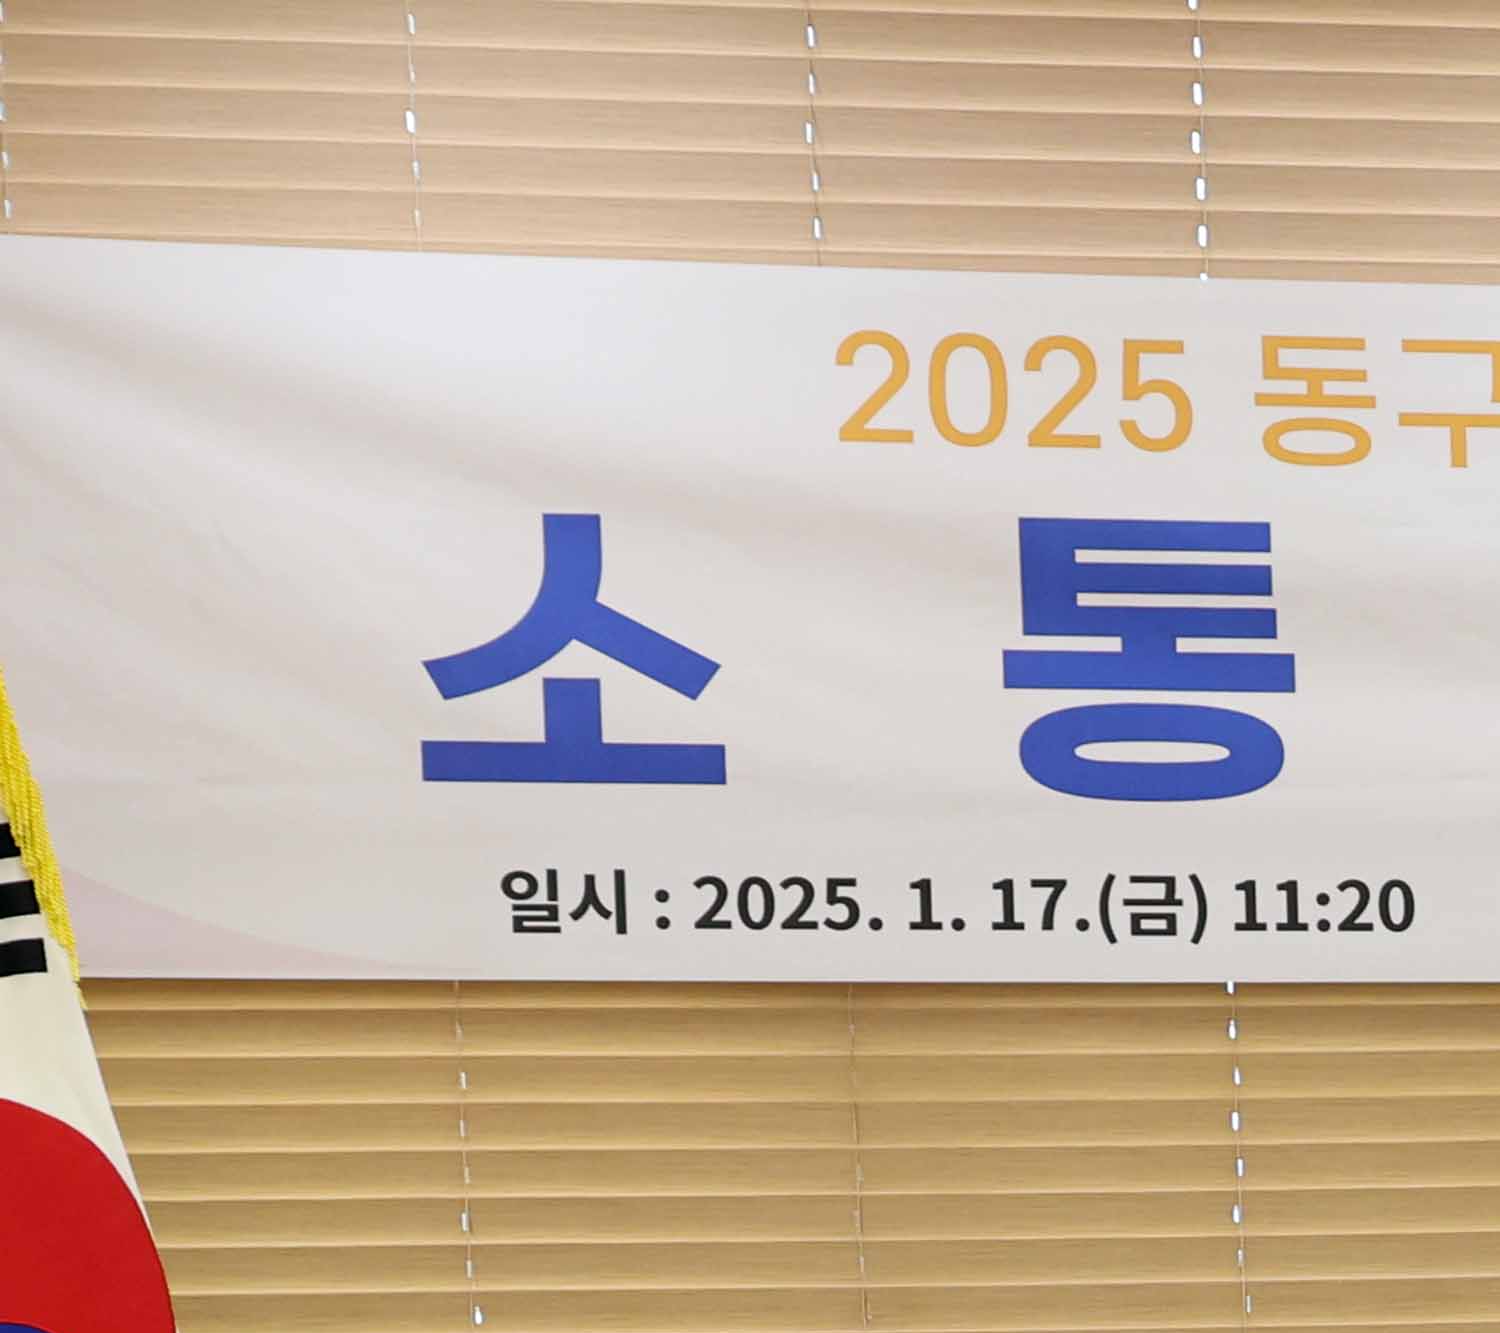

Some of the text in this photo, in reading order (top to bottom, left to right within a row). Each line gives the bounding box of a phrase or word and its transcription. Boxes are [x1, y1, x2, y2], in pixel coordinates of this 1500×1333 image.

[837, 329, 1193, 452] 2025
[421, 514, 727, 786] 소
[1002, 517, 1297, 802] 통
[501, 868, 628, 936] 일시
[692, 876, 884, 931] 2025.
[909, 878, 967, 932] 1.
[991, 873, 1208, 945] 17.(금)
[1234, 879, 1416, 933] 11:20
